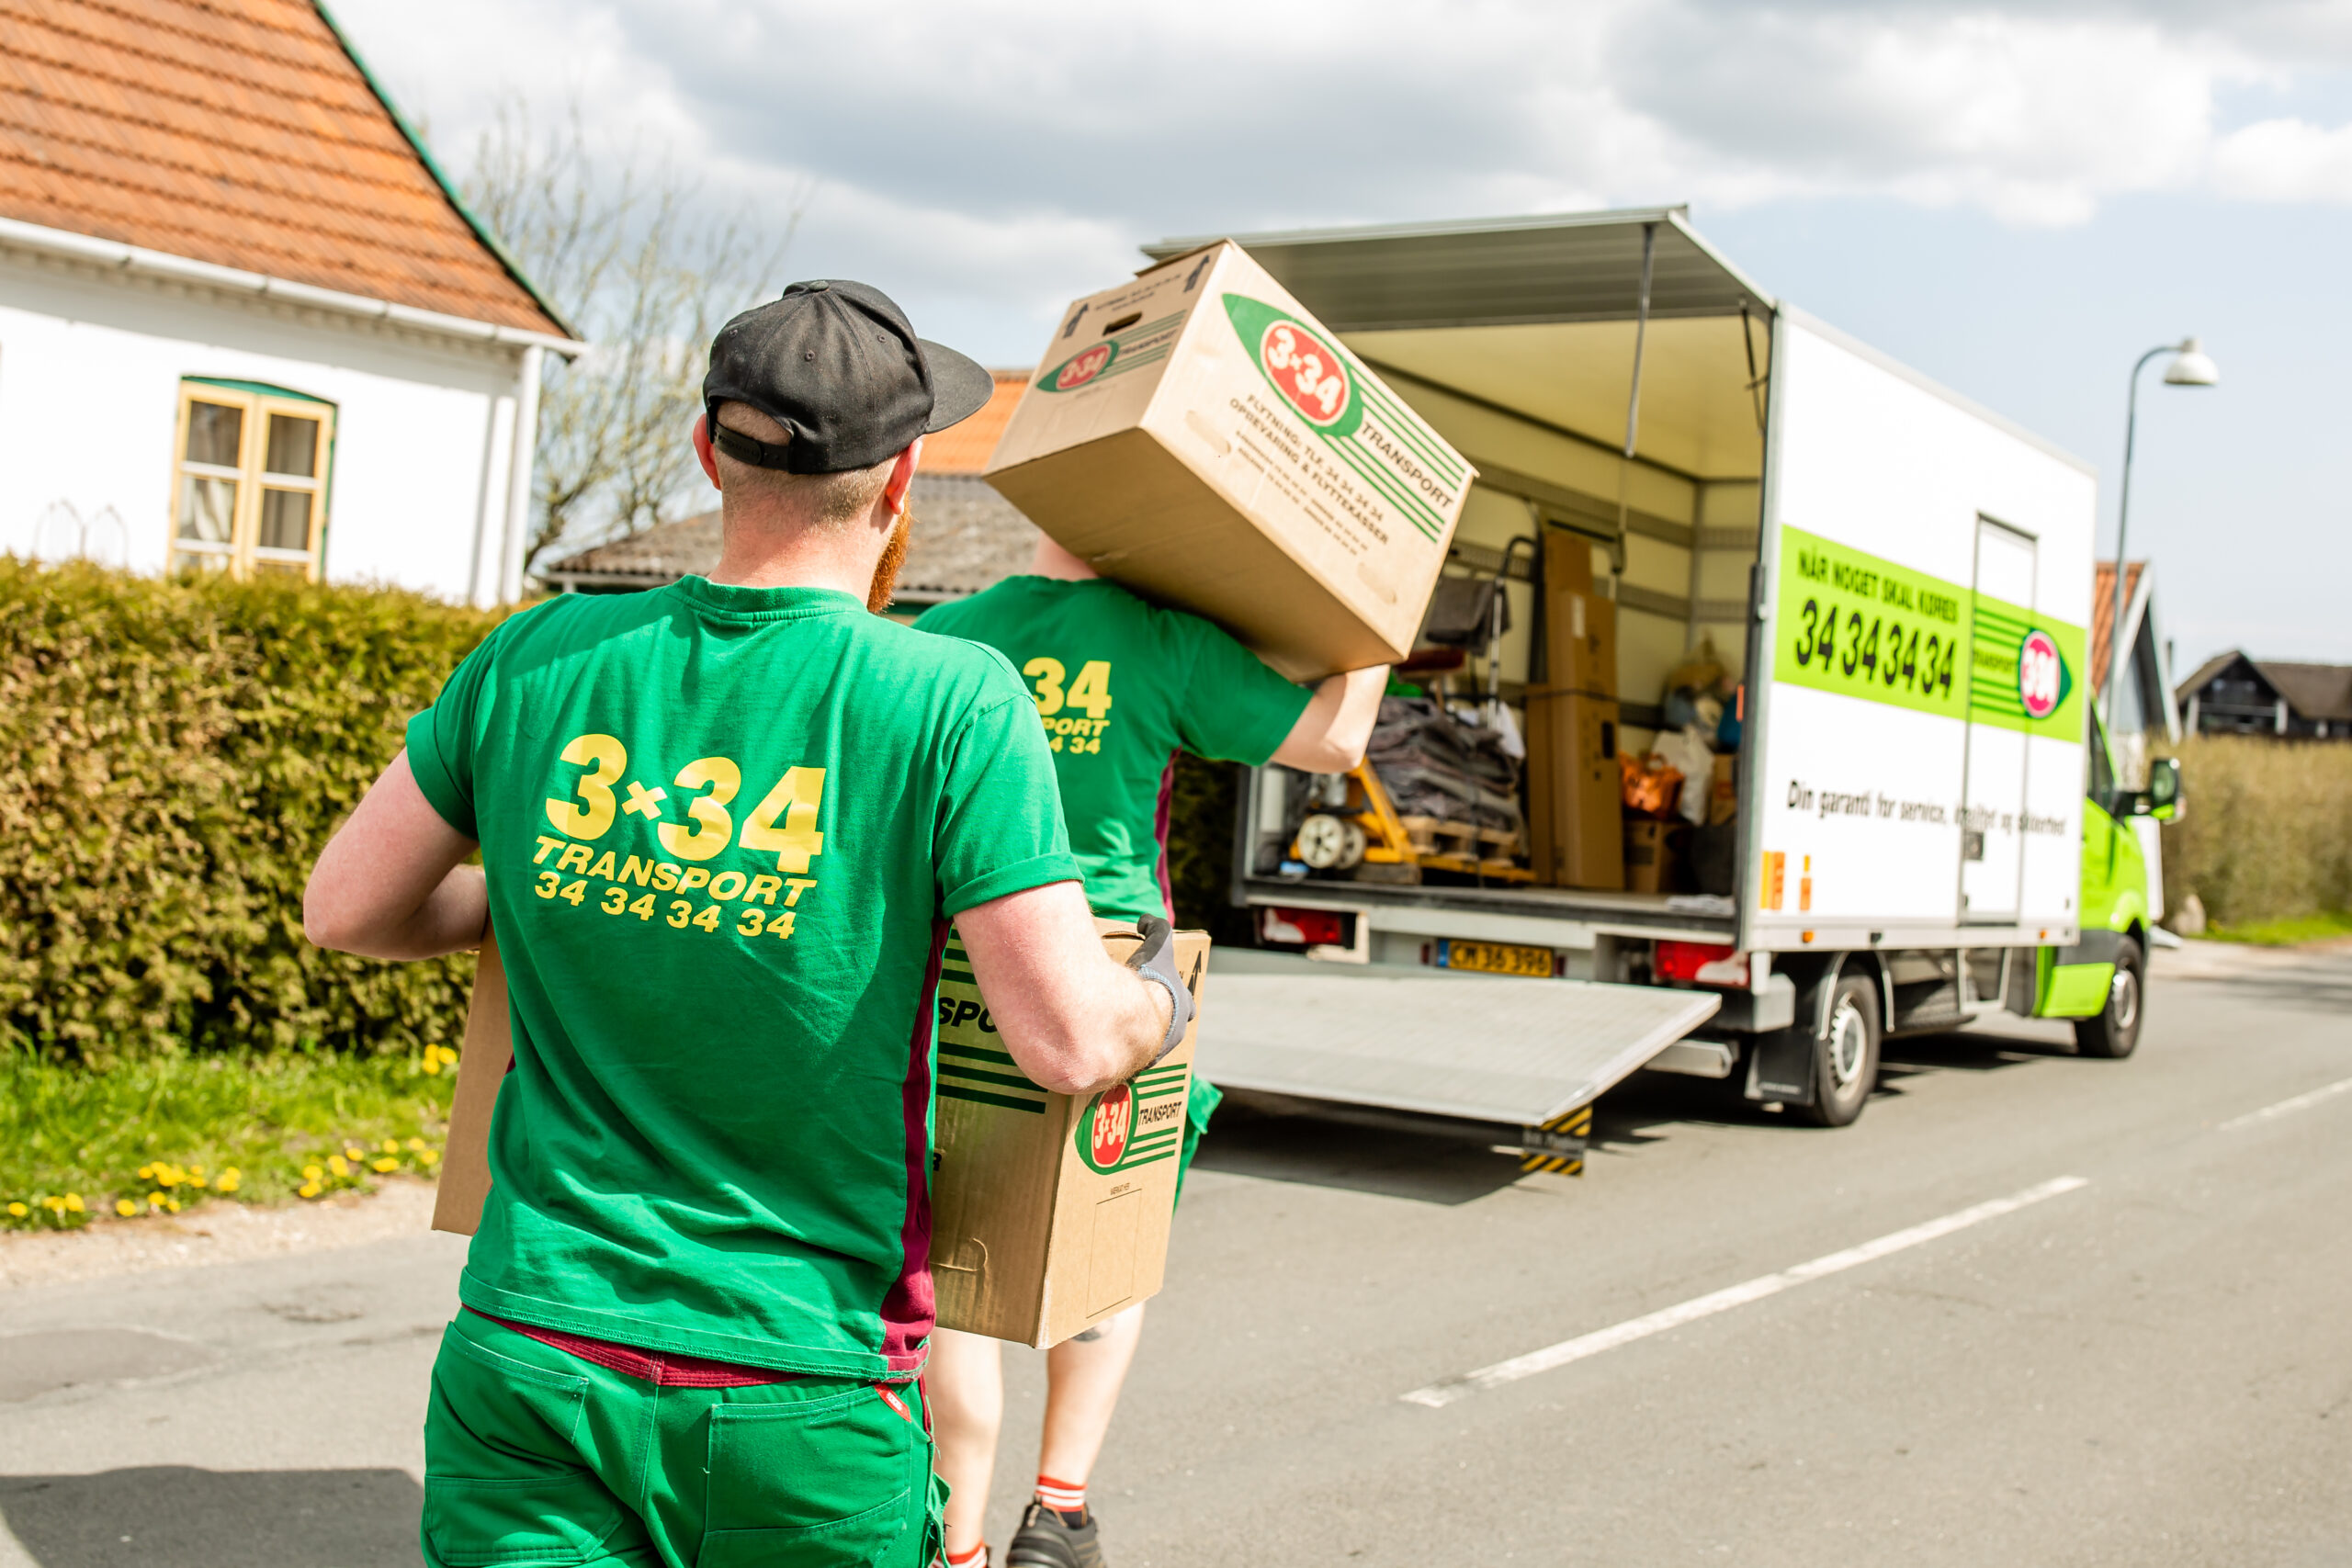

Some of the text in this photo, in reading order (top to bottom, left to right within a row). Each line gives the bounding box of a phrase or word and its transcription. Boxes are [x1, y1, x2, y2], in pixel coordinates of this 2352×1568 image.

[1361, 421, 1454, 509] TRANSPORT
[1832, 559, 1878, 599] NOGET
[1023, 656, 1113, 719] 34
[1069, 737, 1101, 755] 34
[533, 835, 818, 908] TRANSPORT
[535, 871, 797, 940] 34 34 34 34
[1138, 1101, 1182, 1126] TRANSPORT
